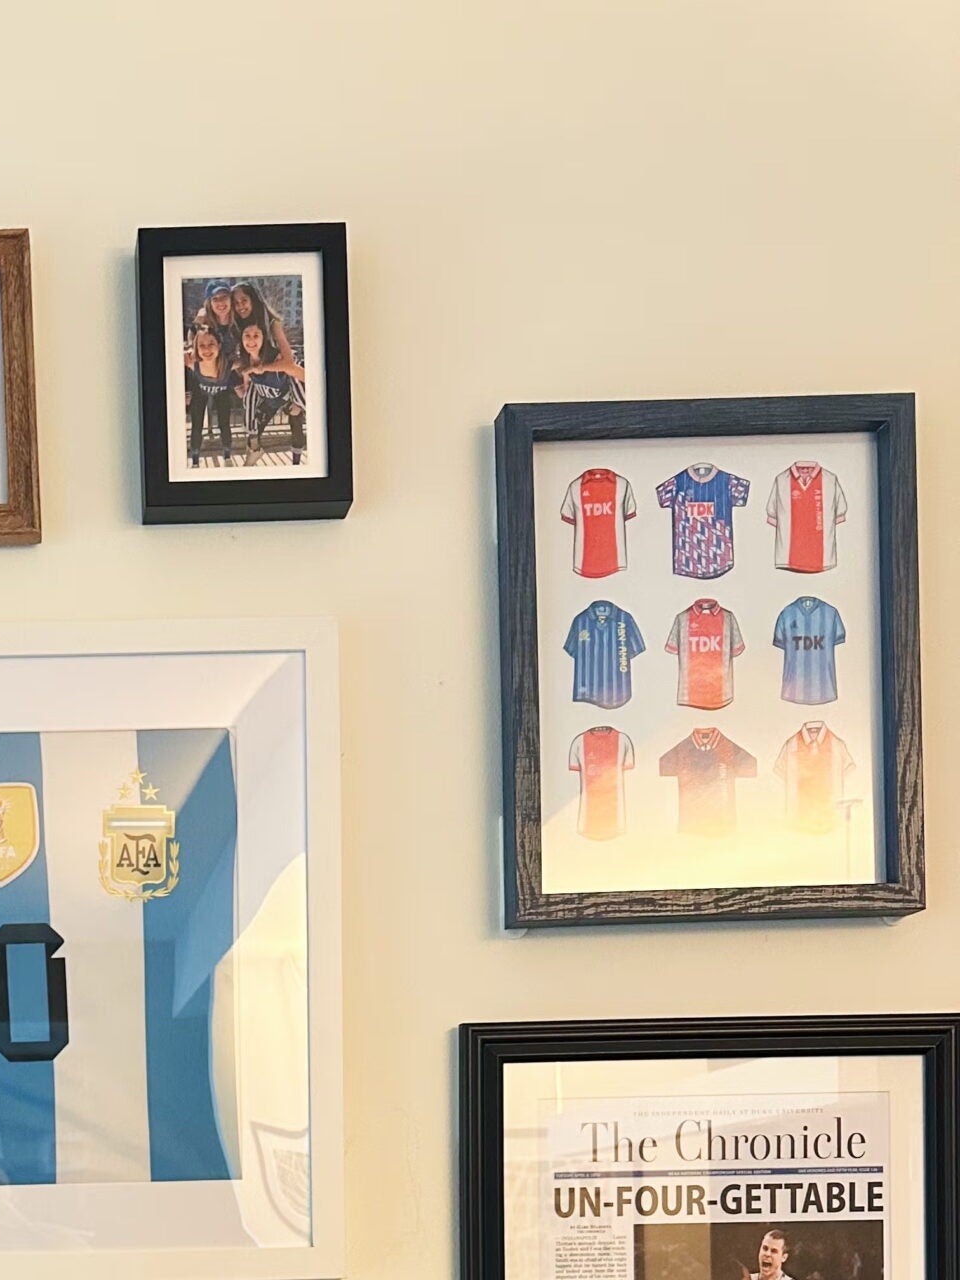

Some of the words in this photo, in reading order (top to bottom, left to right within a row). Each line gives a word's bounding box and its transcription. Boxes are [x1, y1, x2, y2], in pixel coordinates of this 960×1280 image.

[583, 502, 613, 517] TDK
[689, 502, 715, 517] TDK
[689, 636, 722, 652] TDK
[792, 635, 825, 651] TDK
[580, 1121, 658, 1163] The
[675, 1116, 867, 1163] Chronicle
[554, 1181, 884, 1219] UN-FOUR-GETTABLE
